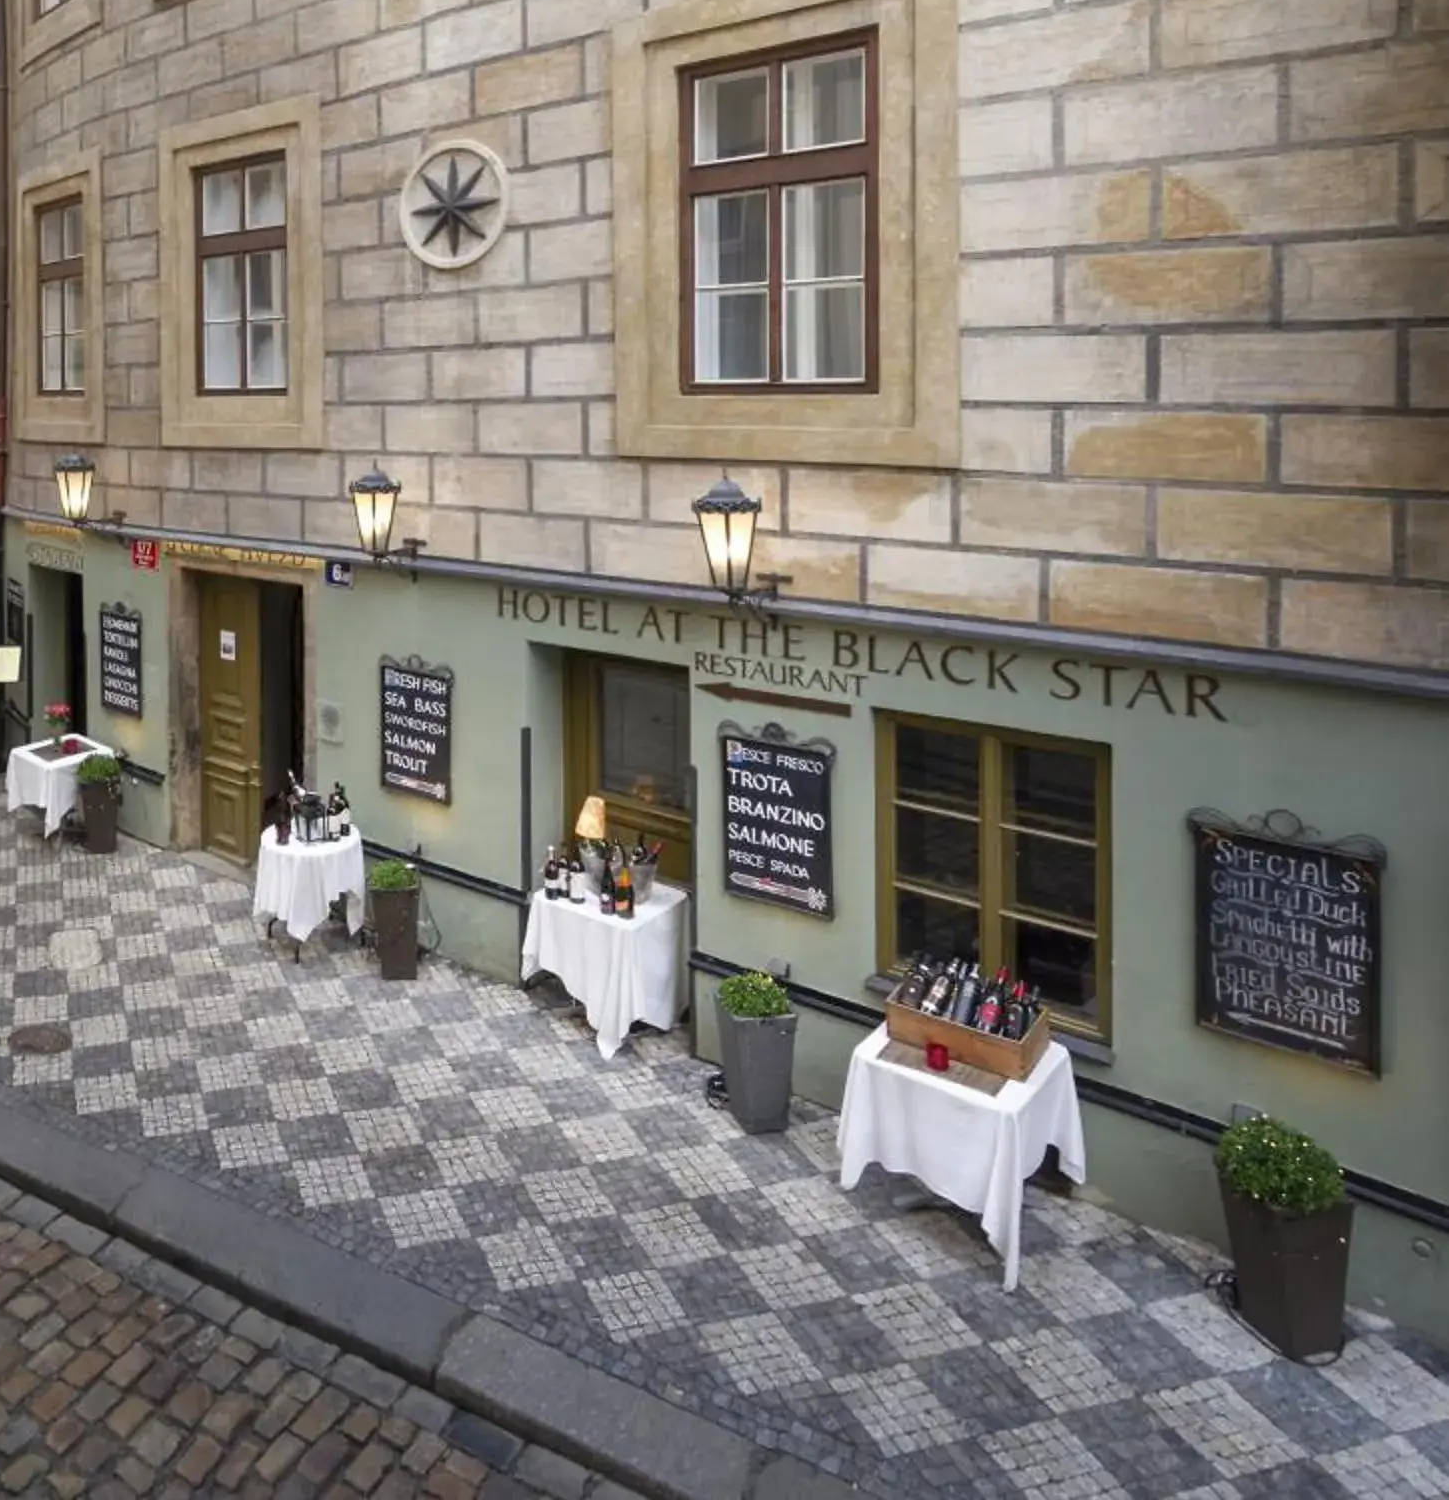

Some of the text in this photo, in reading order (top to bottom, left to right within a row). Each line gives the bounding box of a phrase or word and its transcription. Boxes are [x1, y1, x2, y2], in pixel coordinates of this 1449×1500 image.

[496, 586, 1230, 723] HOTEL AT THE BLACK STAR
[384, 667, 447, 696] FRESH FISH
[694, 651, 869, 698] RESTAURANT
[384, 691, 447, 718] SEA BASS
[384, 711, 447, 737] SWORDFISH
[384, 729, 437, 756] SALMON
[726, 739, 825, 776] PESCE FRESCO
[384, 749, 428, 775] TROUT
[726, 767, 794, 798] TROTA
[727, 795, 826, 832] BRANZINO
[727, 821, 815, 858] SALMONE
[727, 849, 810, 881] PESCE SPADA
[1307, 892, 1367, 928] Duck
[1326, 935, 1373, 963] with
